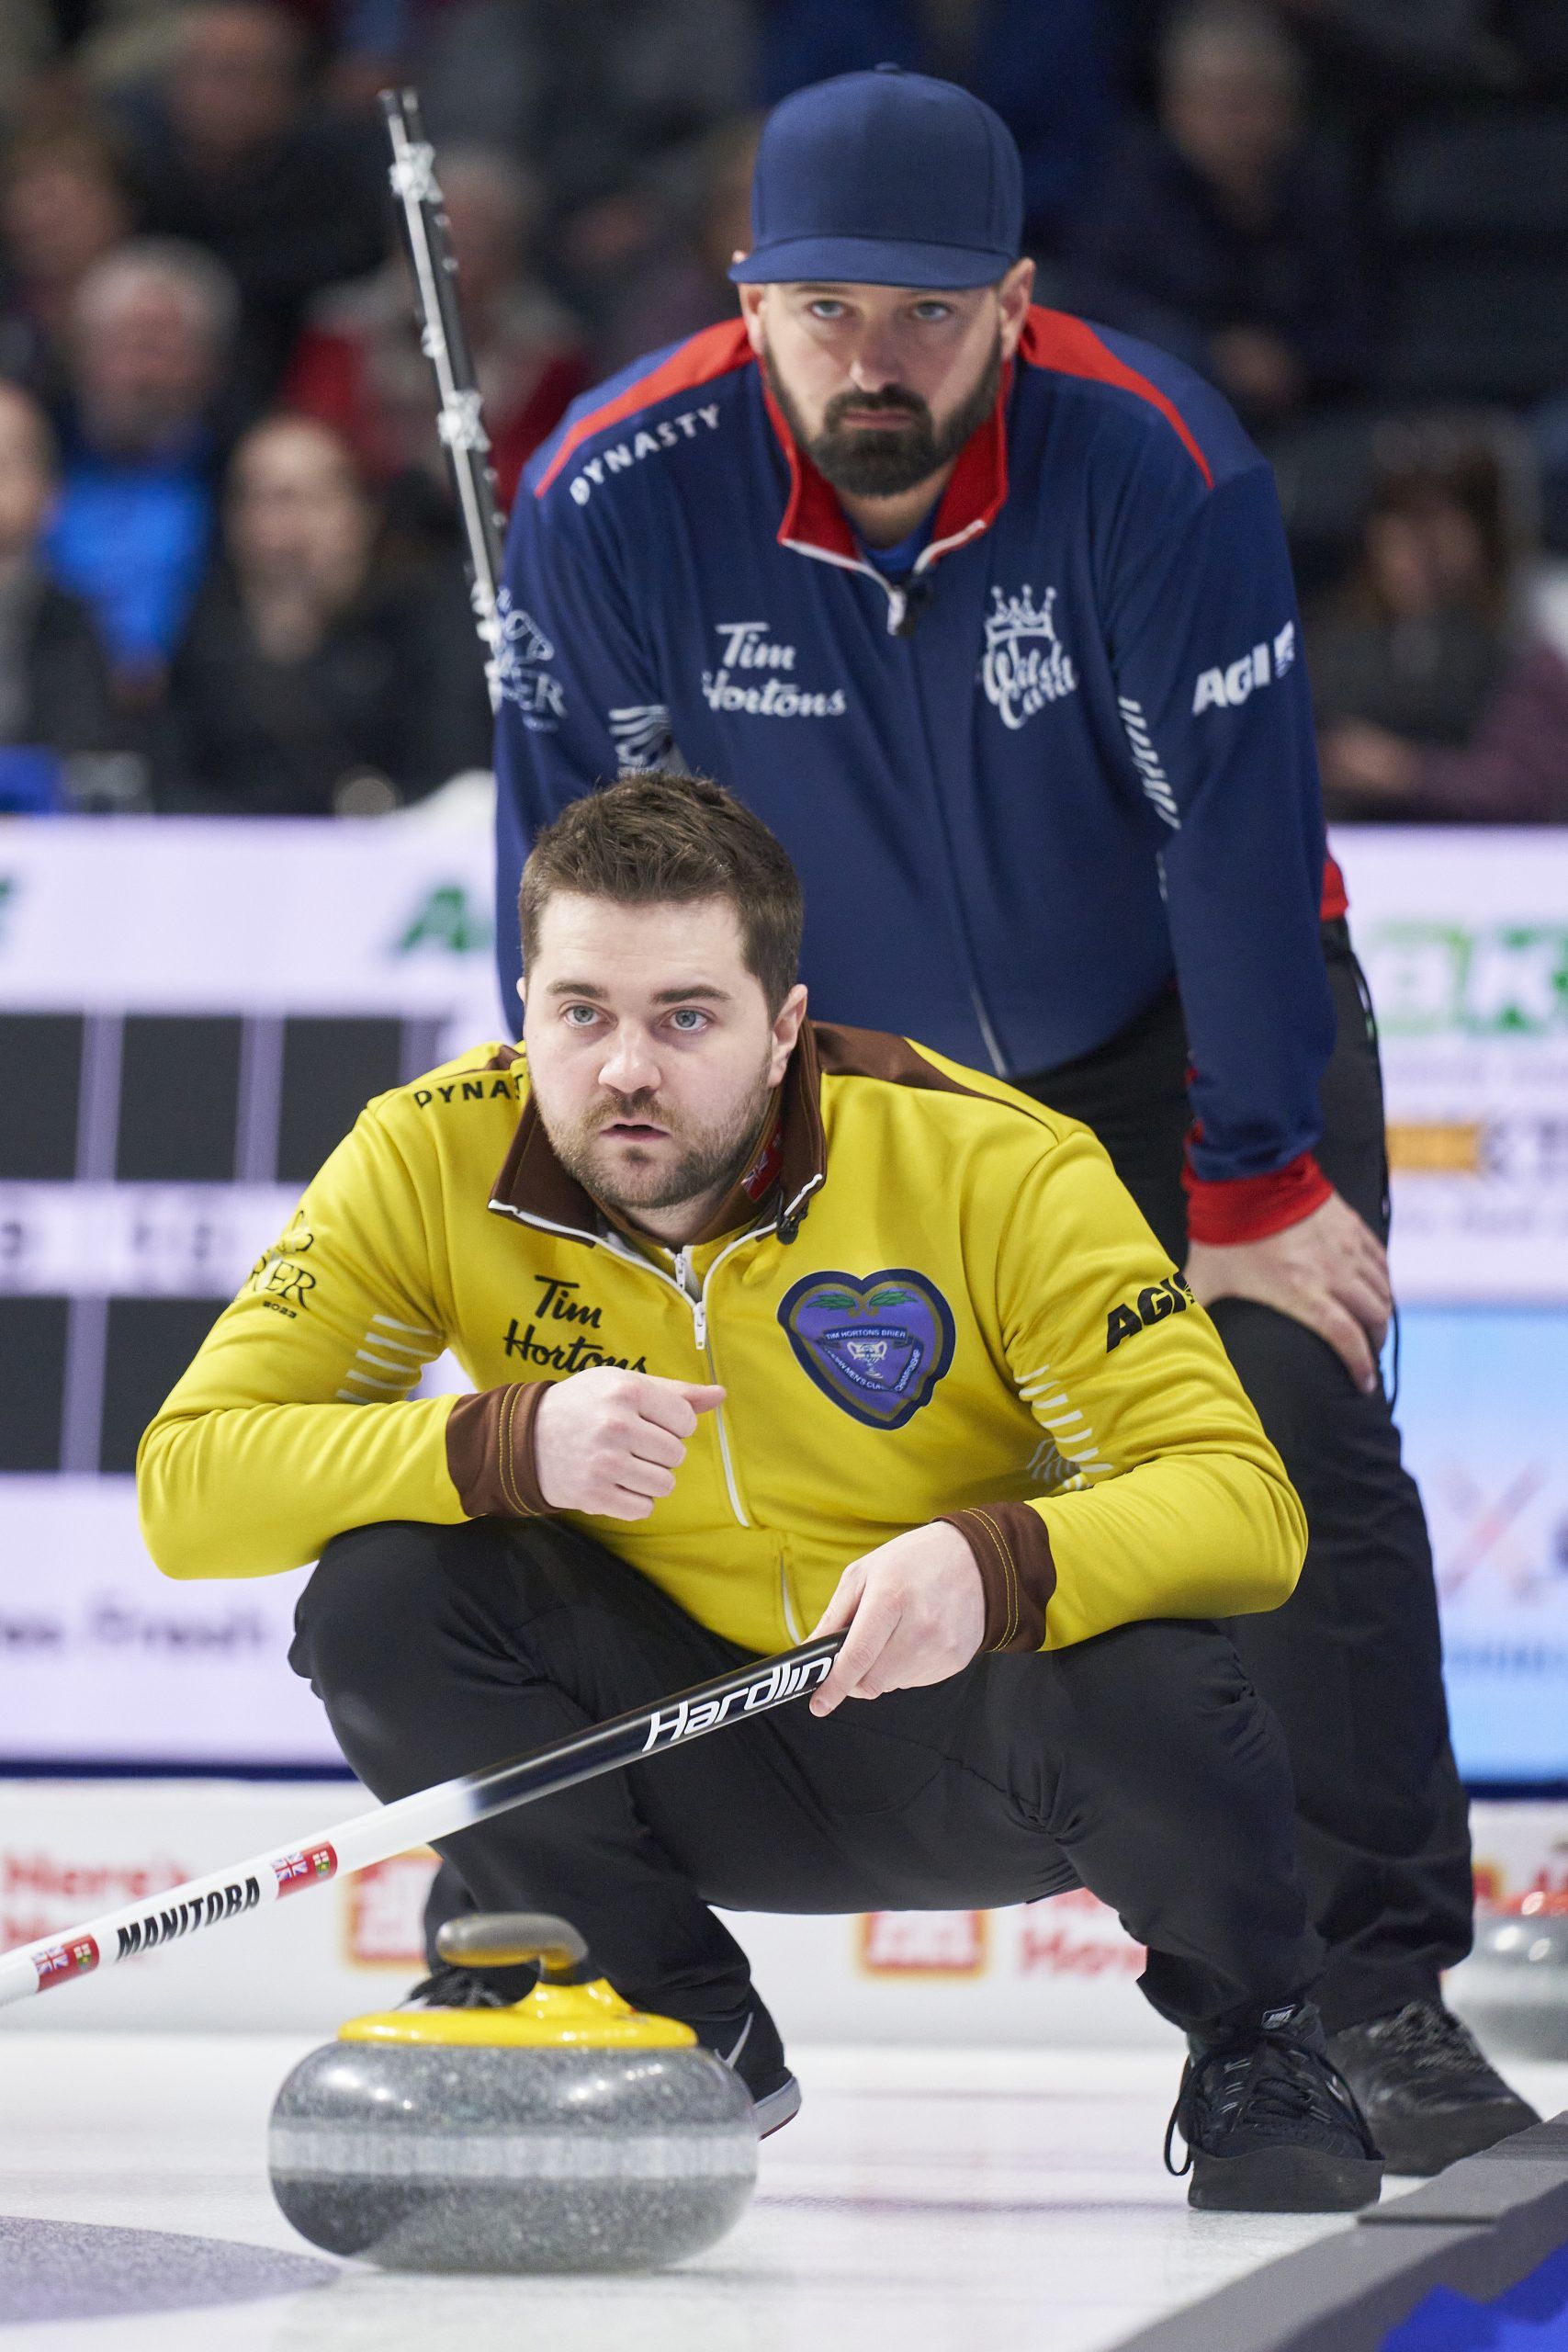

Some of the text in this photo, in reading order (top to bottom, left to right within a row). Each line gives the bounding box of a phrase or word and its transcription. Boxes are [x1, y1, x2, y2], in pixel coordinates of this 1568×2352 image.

[570, 402, 719, 505] DYNASTY
[715, 622, 795, 671] Tim
[701, 668, 846, 718] Hortons
[1193, 642, 1270, 716] AGI
[413, 1073, 524, 1109] DYNA
[534, 1274, 603, 1329] Tim
[1106, 1277, 1188, 1354] AGI
[826, 1329, 906, 1340] TIM HORTONS BRIER
[642, 1657, 837, 1753] Hardlin
[116, 1876, 260, 1963] MANITOBA
